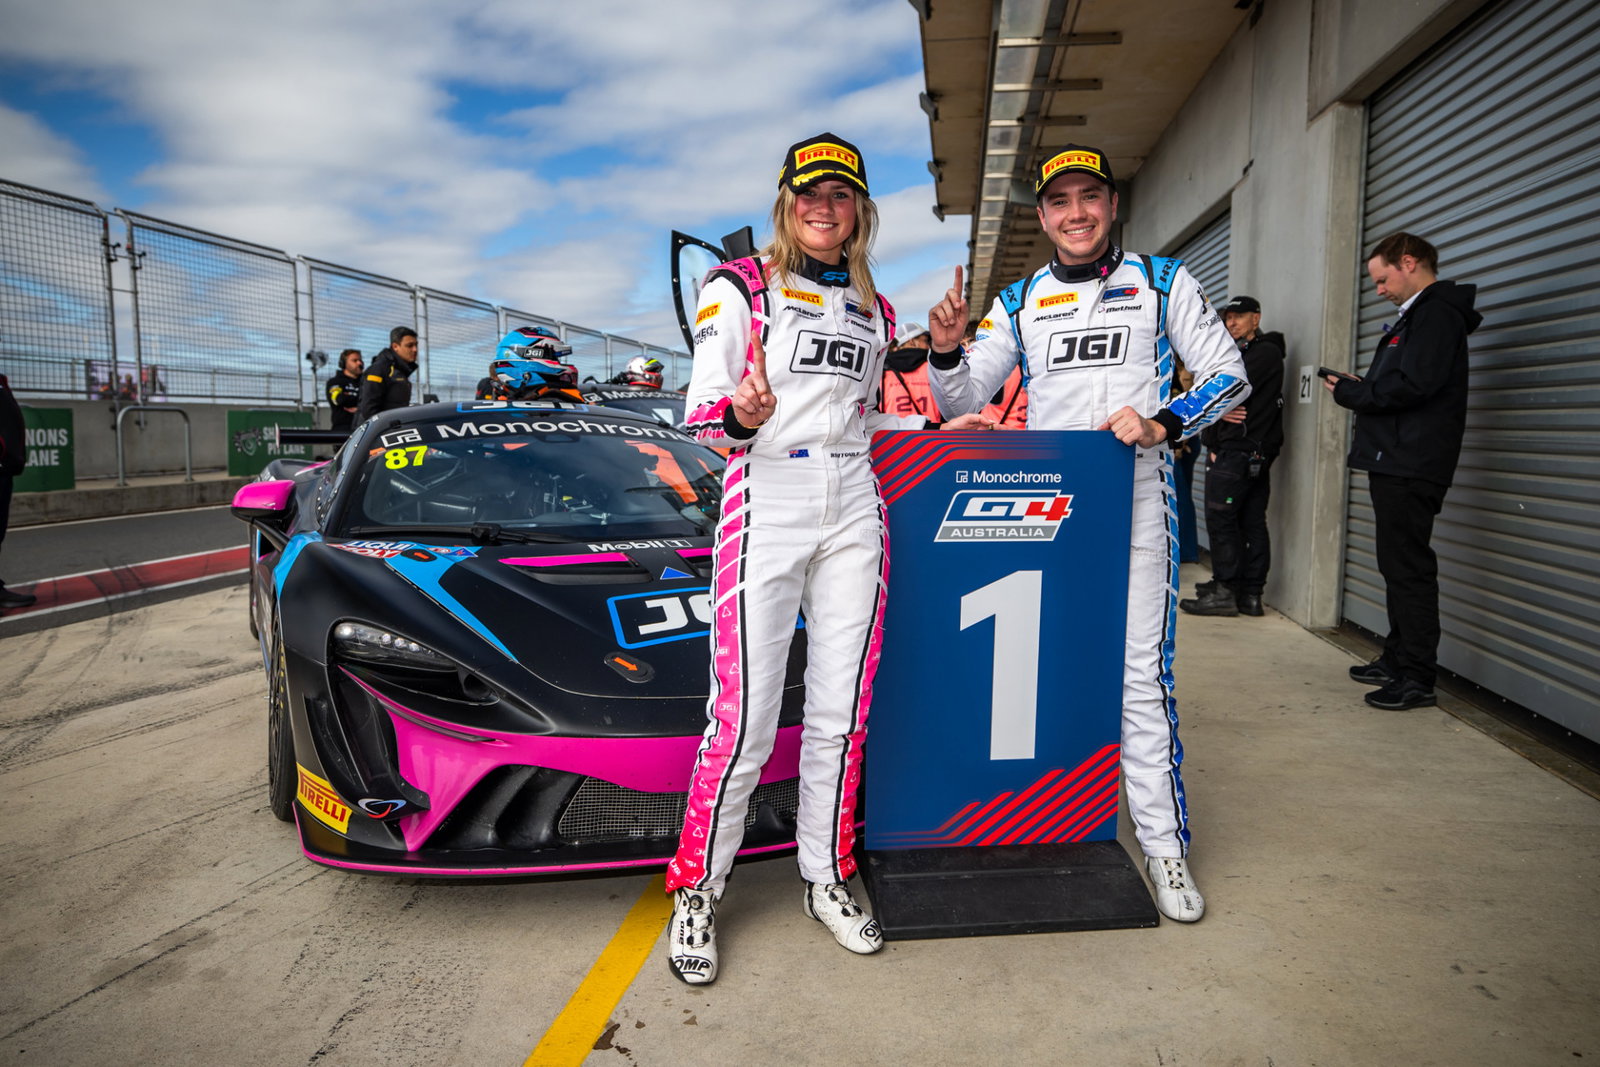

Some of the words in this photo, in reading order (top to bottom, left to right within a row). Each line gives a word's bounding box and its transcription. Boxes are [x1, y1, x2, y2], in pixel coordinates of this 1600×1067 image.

[799, 146, 855, 166] PIRELLI
[1044, 154, 1097, 174] PIRELLI
[784, 289, 820, 304] PIRELLI
[1007, 286, 1018, 303] RX
[1039, 293, 1075, 307] PIRELLI
[783, 305, 825, 318] McLaren
[1033, 308, 1079, 322] McLaren
[525, 350, 542, 358] JGI
[799, 338, 866, 373] JGI
[1053, 333, 1122, 364] JGI
[1301, 374, 1311, 398] 21
[895, 395, 927, 412] 21
[25, 428, 68, 447] NONS
[25, 449, 60, 467] ANE
[384, 445, 428, 470] 87
[973, 471, 1063, 484] Monochrome
[962, 497, 1070, 521] GT4
[950, 528, 1045, 538] AUSTRALIA
[347, 540, 417, 551] LIQUI
[588, 541, 665, 552] Mobil
[960, 570, 1043, 761] 1
[299, 771, 347, 822] PIRELLI
[674, 959, 710, 971] OMP
